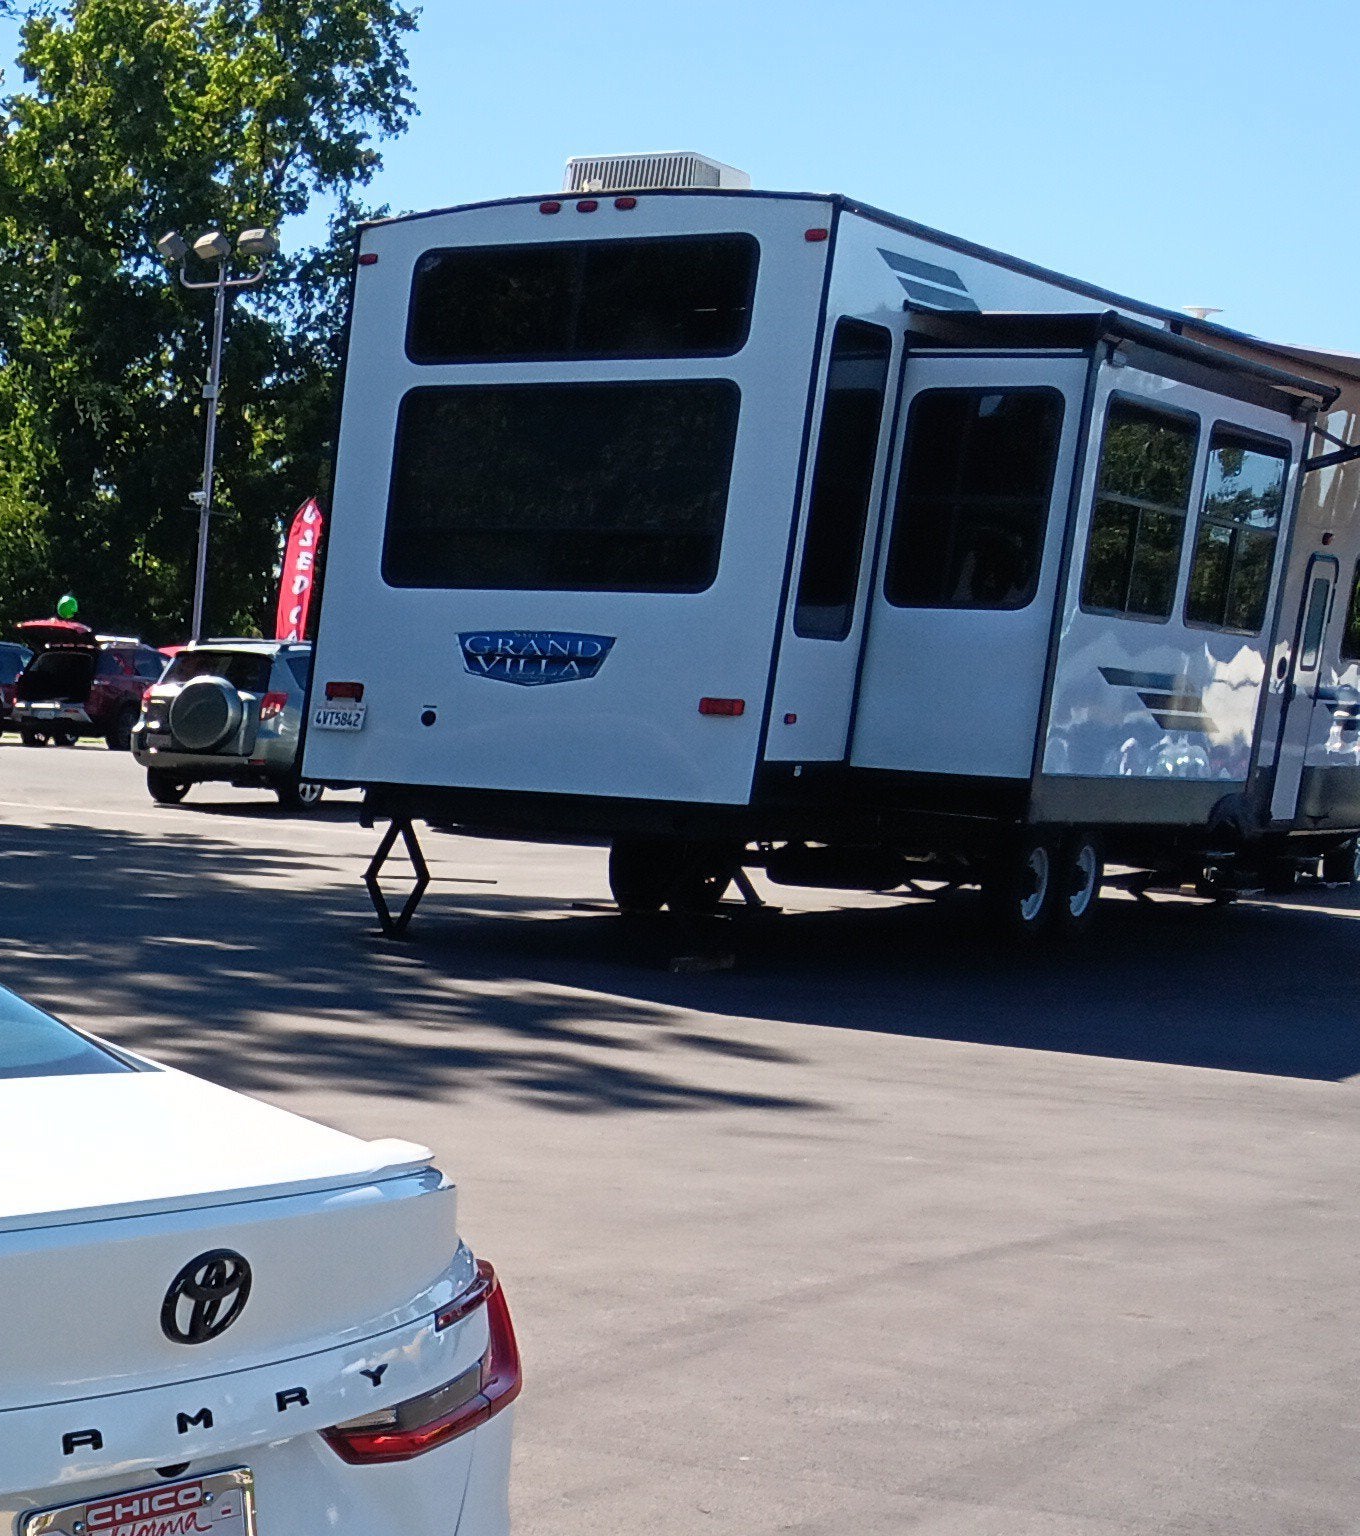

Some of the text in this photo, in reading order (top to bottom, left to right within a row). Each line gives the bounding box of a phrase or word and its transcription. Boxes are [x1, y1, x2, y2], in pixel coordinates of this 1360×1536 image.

[291, 504, 316, 596] USED
[464, 635, 602, 658] GRAND
[476, 656, 580, 676] VILLA
[315, 710, 361, 727] 4VT5842
[86, 1485, 202, 1527] CHICO
